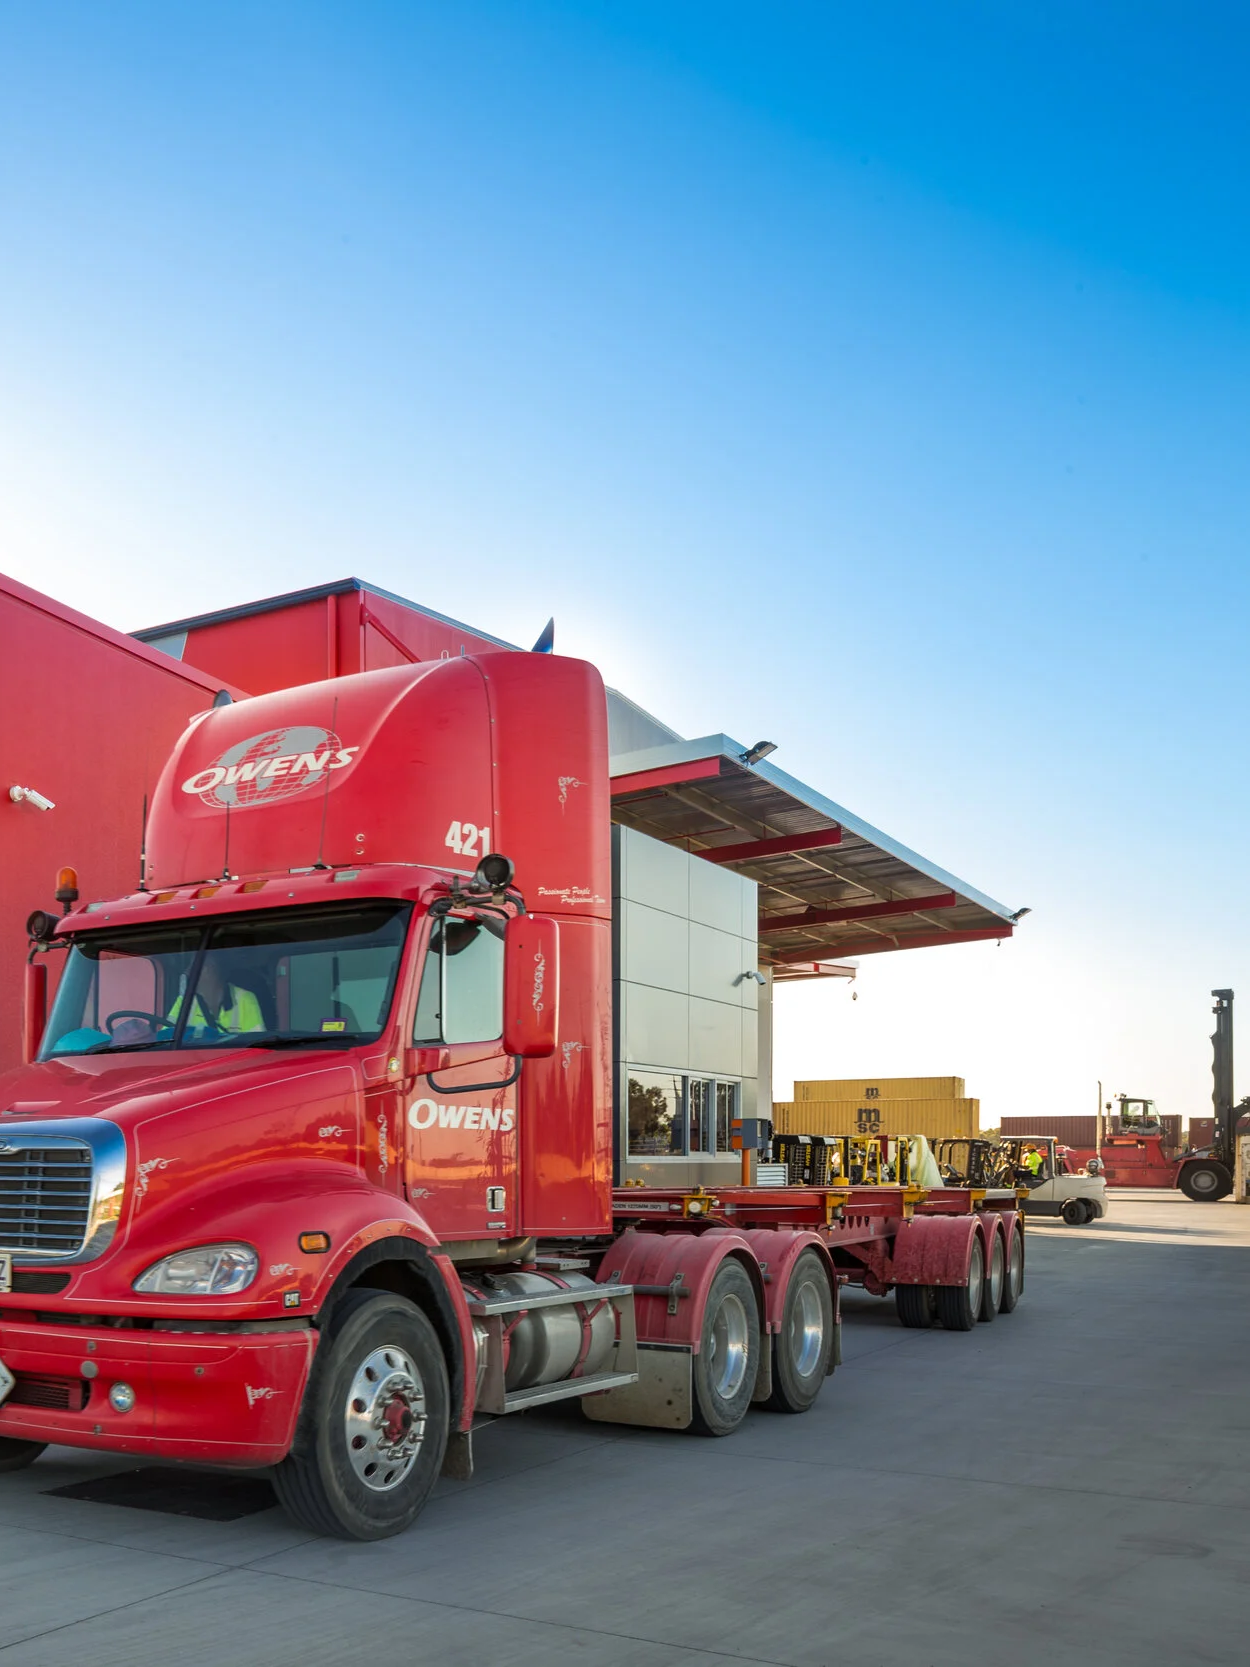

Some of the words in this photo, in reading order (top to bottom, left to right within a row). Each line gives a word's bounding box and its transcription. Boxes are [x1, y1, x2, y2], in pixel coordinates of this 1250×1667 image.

[182, 746, 360, 794] OWENS
[445, 821, 491, 857] 421
[408, 1099, 514, 1131] OWENS
